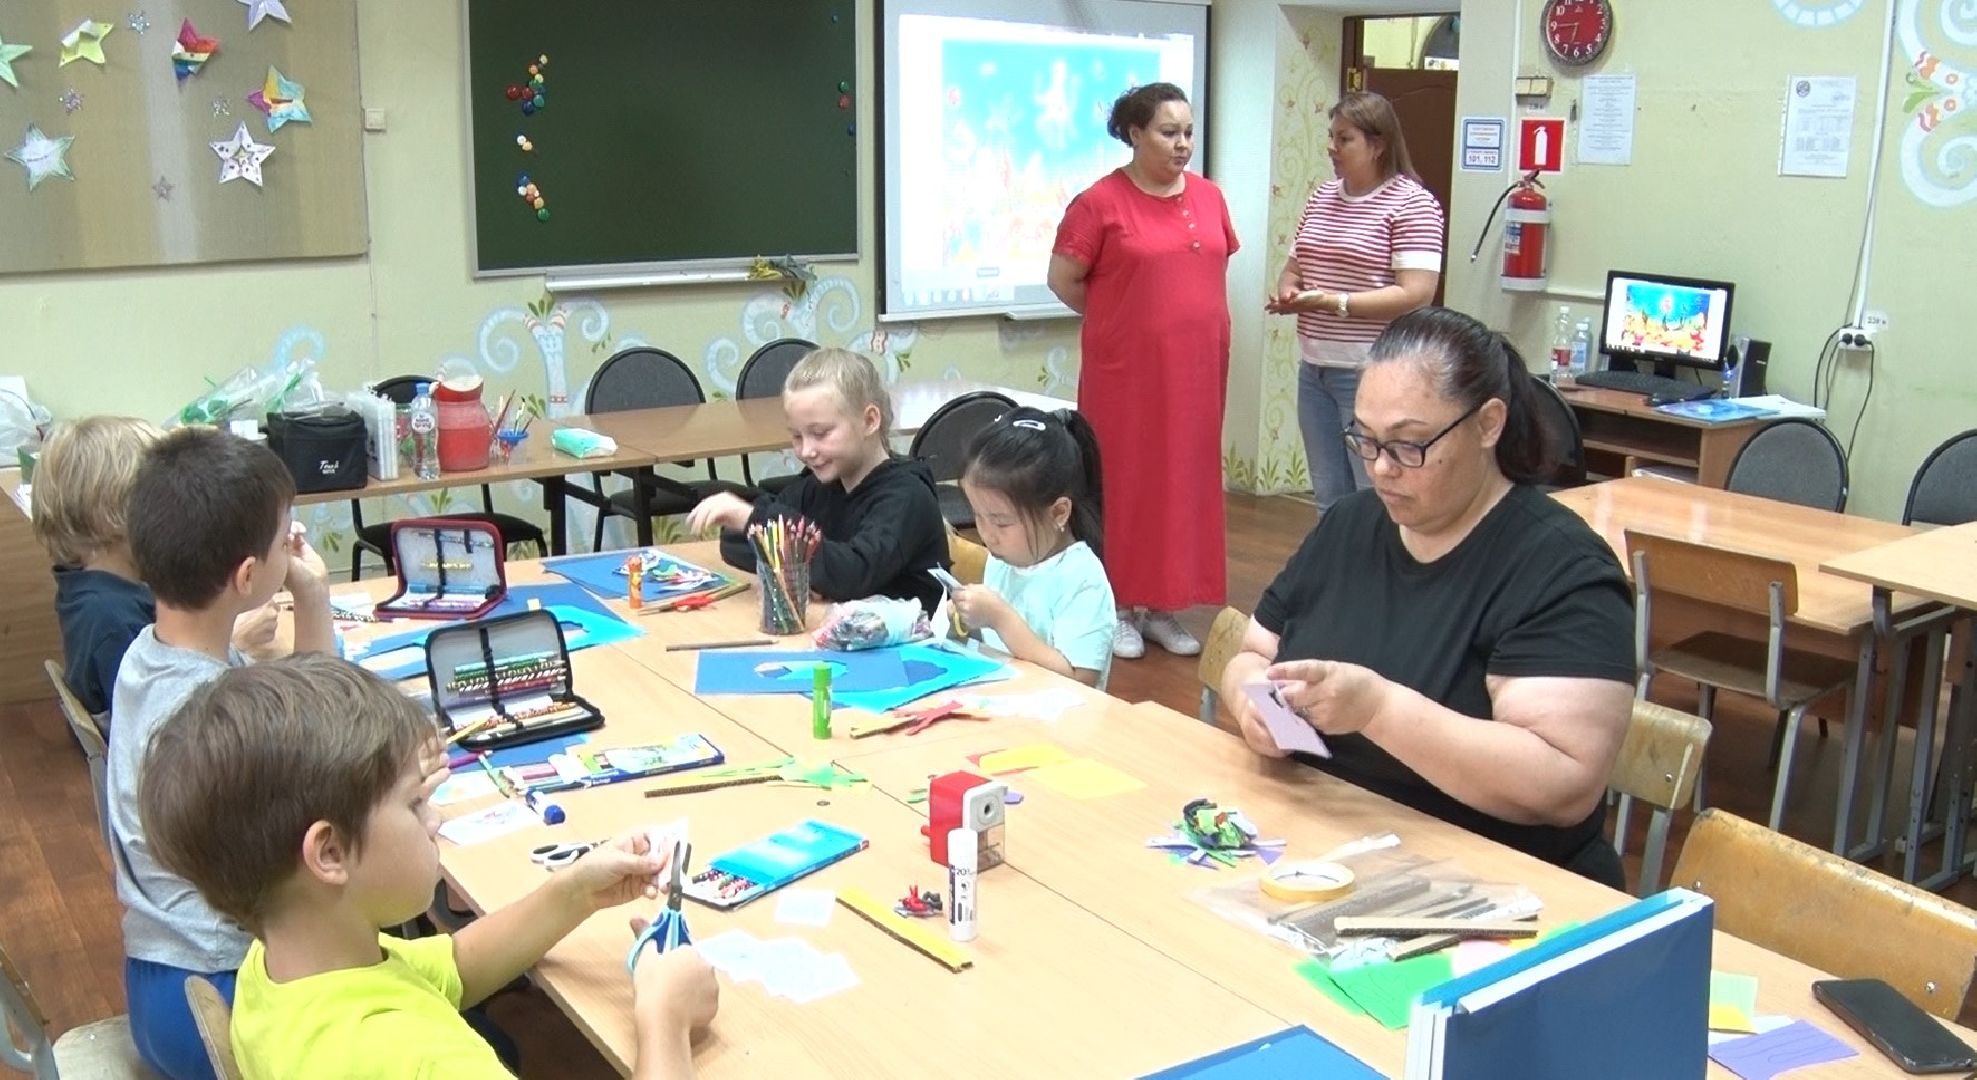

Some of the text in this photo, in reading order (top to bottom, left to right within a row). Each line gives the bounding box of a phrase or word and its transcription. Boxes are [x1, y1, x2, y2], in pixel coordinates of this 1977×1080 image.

[1556, 5, 1565, 16] 10
[1550, 21, 1558, 31] 9
[1554, 33, 1560, 44] 8
[1563, 44, 1569, 54] 7
[1573, 46, 1580, 57] 6
[1586, 44, 1593, 55] 5
